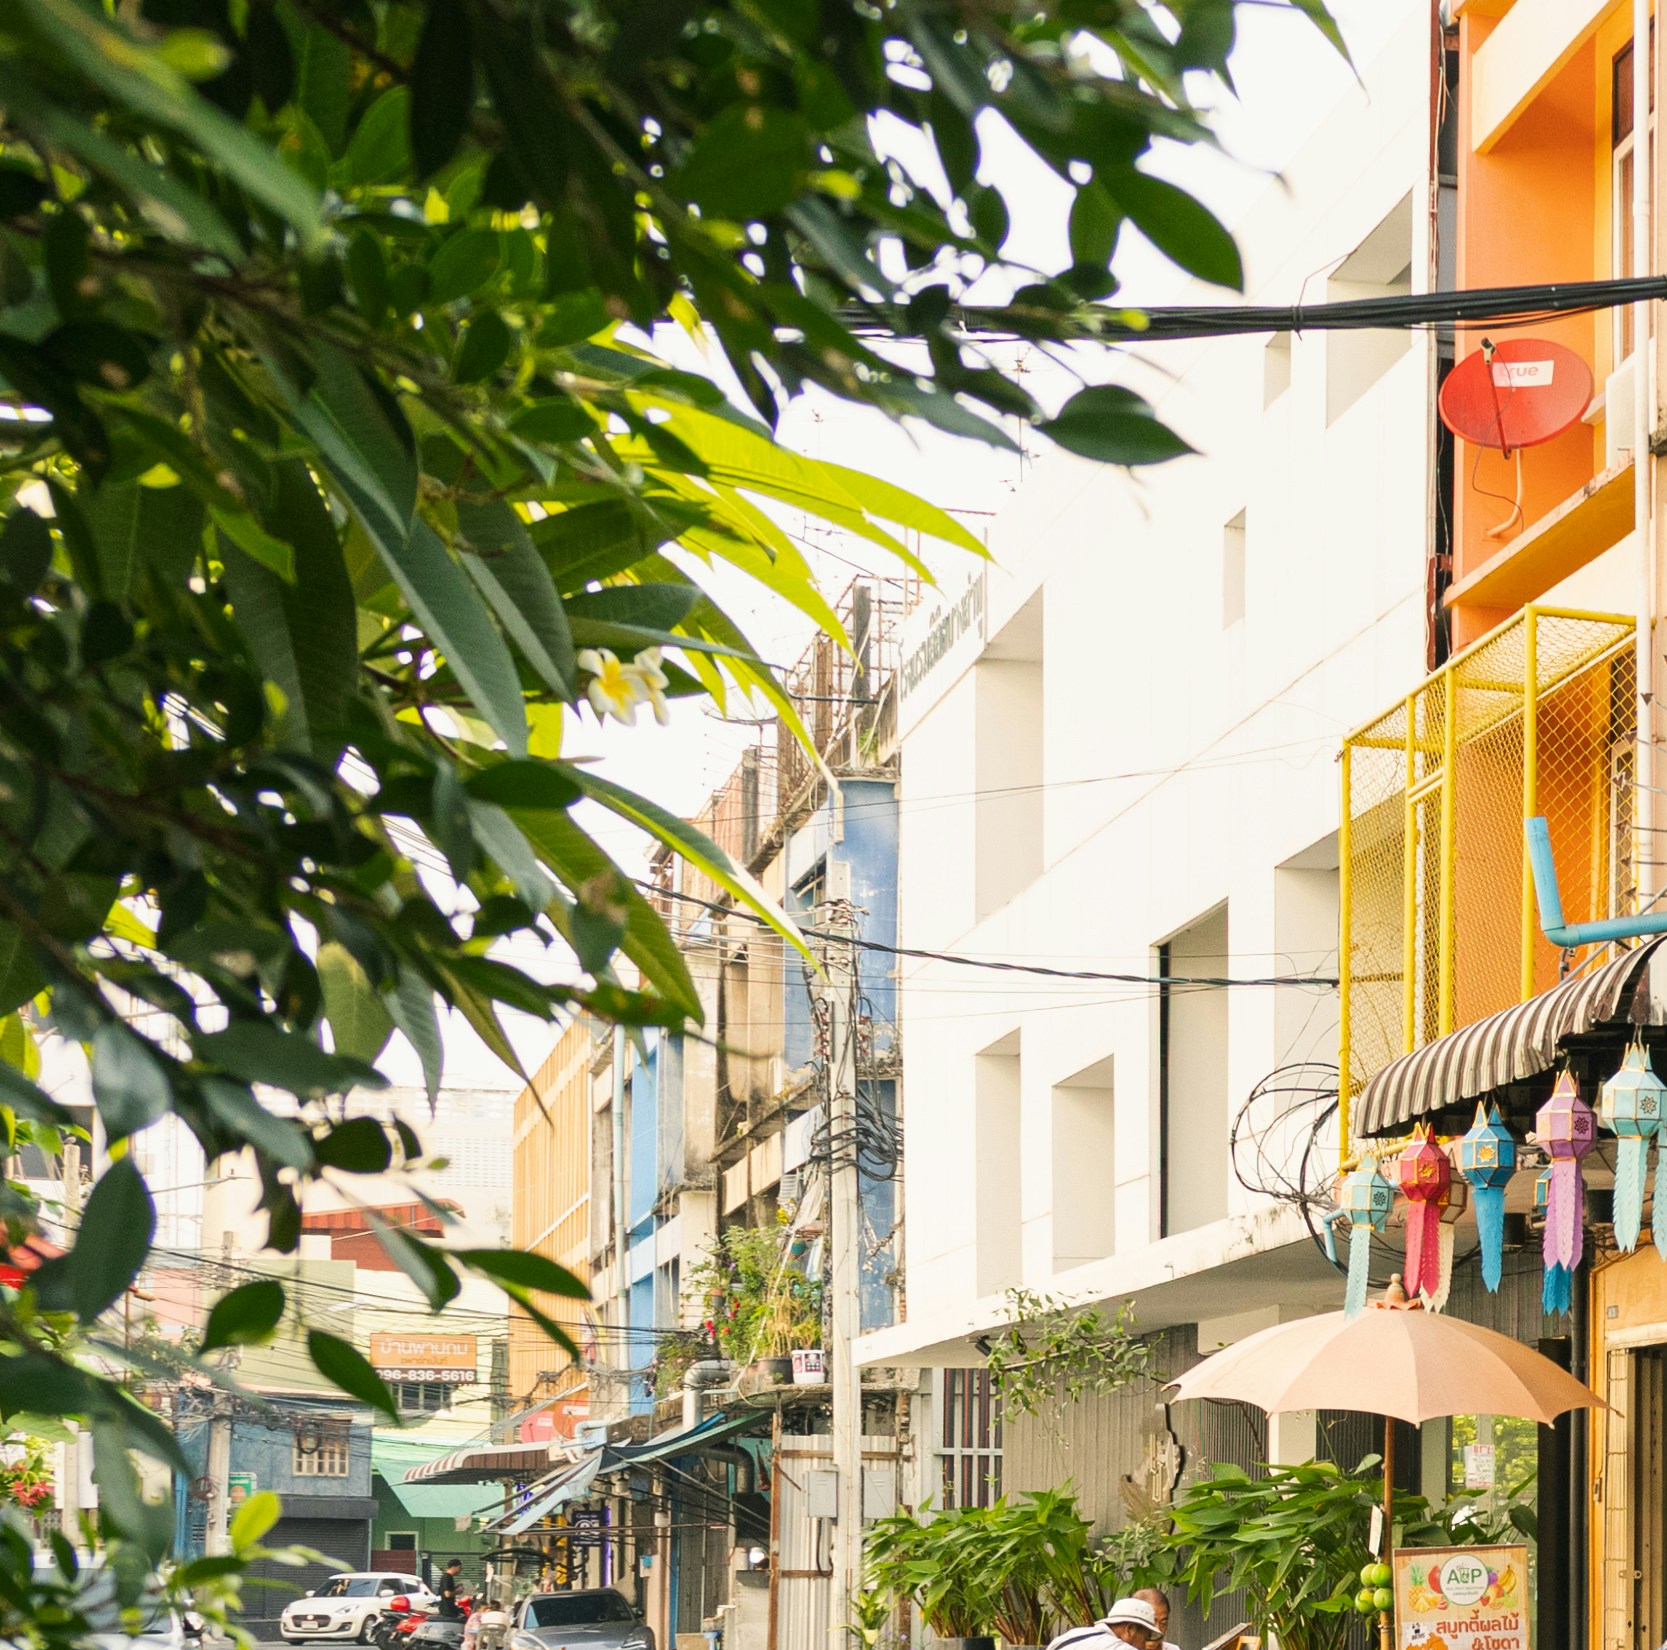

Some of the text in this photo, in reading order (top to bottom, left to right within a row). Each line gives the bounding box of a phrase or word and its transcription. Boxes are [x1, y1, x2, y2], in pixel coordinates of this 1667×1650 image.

[1436, 1609, 1519, 1640] สมูทตี้ผลไม้
[1472, 1635, 1520, 1650] &โซดา
